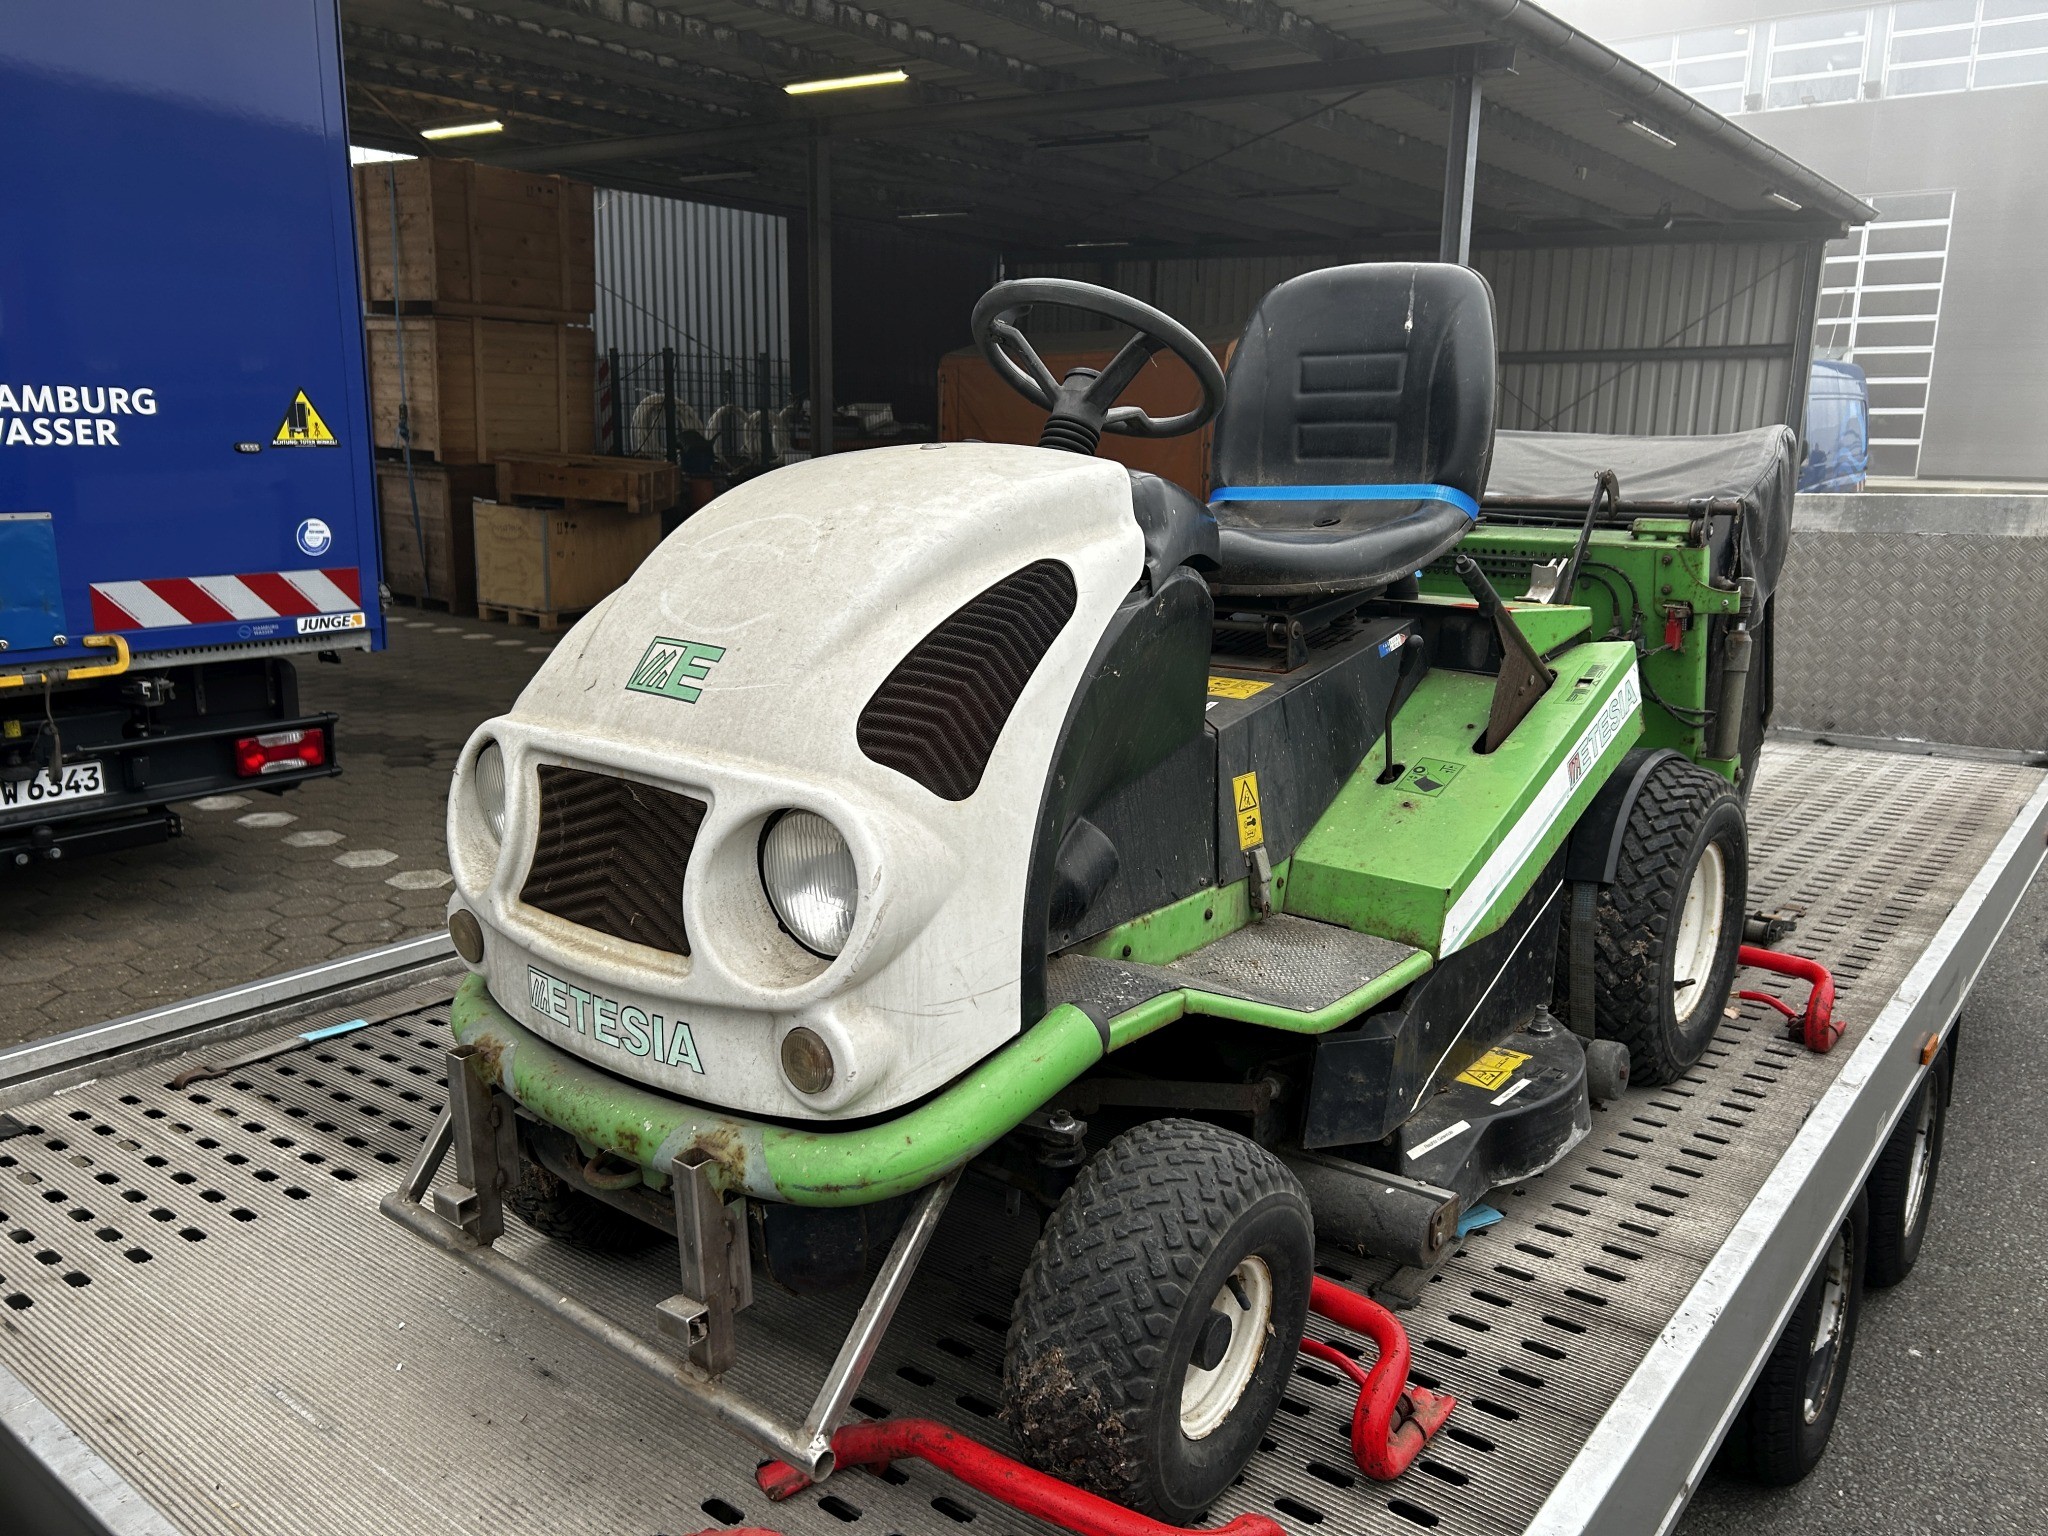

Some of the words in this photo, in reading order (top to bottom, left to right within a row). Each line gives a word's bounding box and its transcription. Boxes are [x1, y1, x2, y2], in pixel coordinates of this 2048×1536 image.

[0, 417, 120, 446] ASSER
[300, 615, 351, 632] JUNGE
[1570, 680, 1637, 788] ETESIA
[530, 964, 705, 1075] ETESIA
